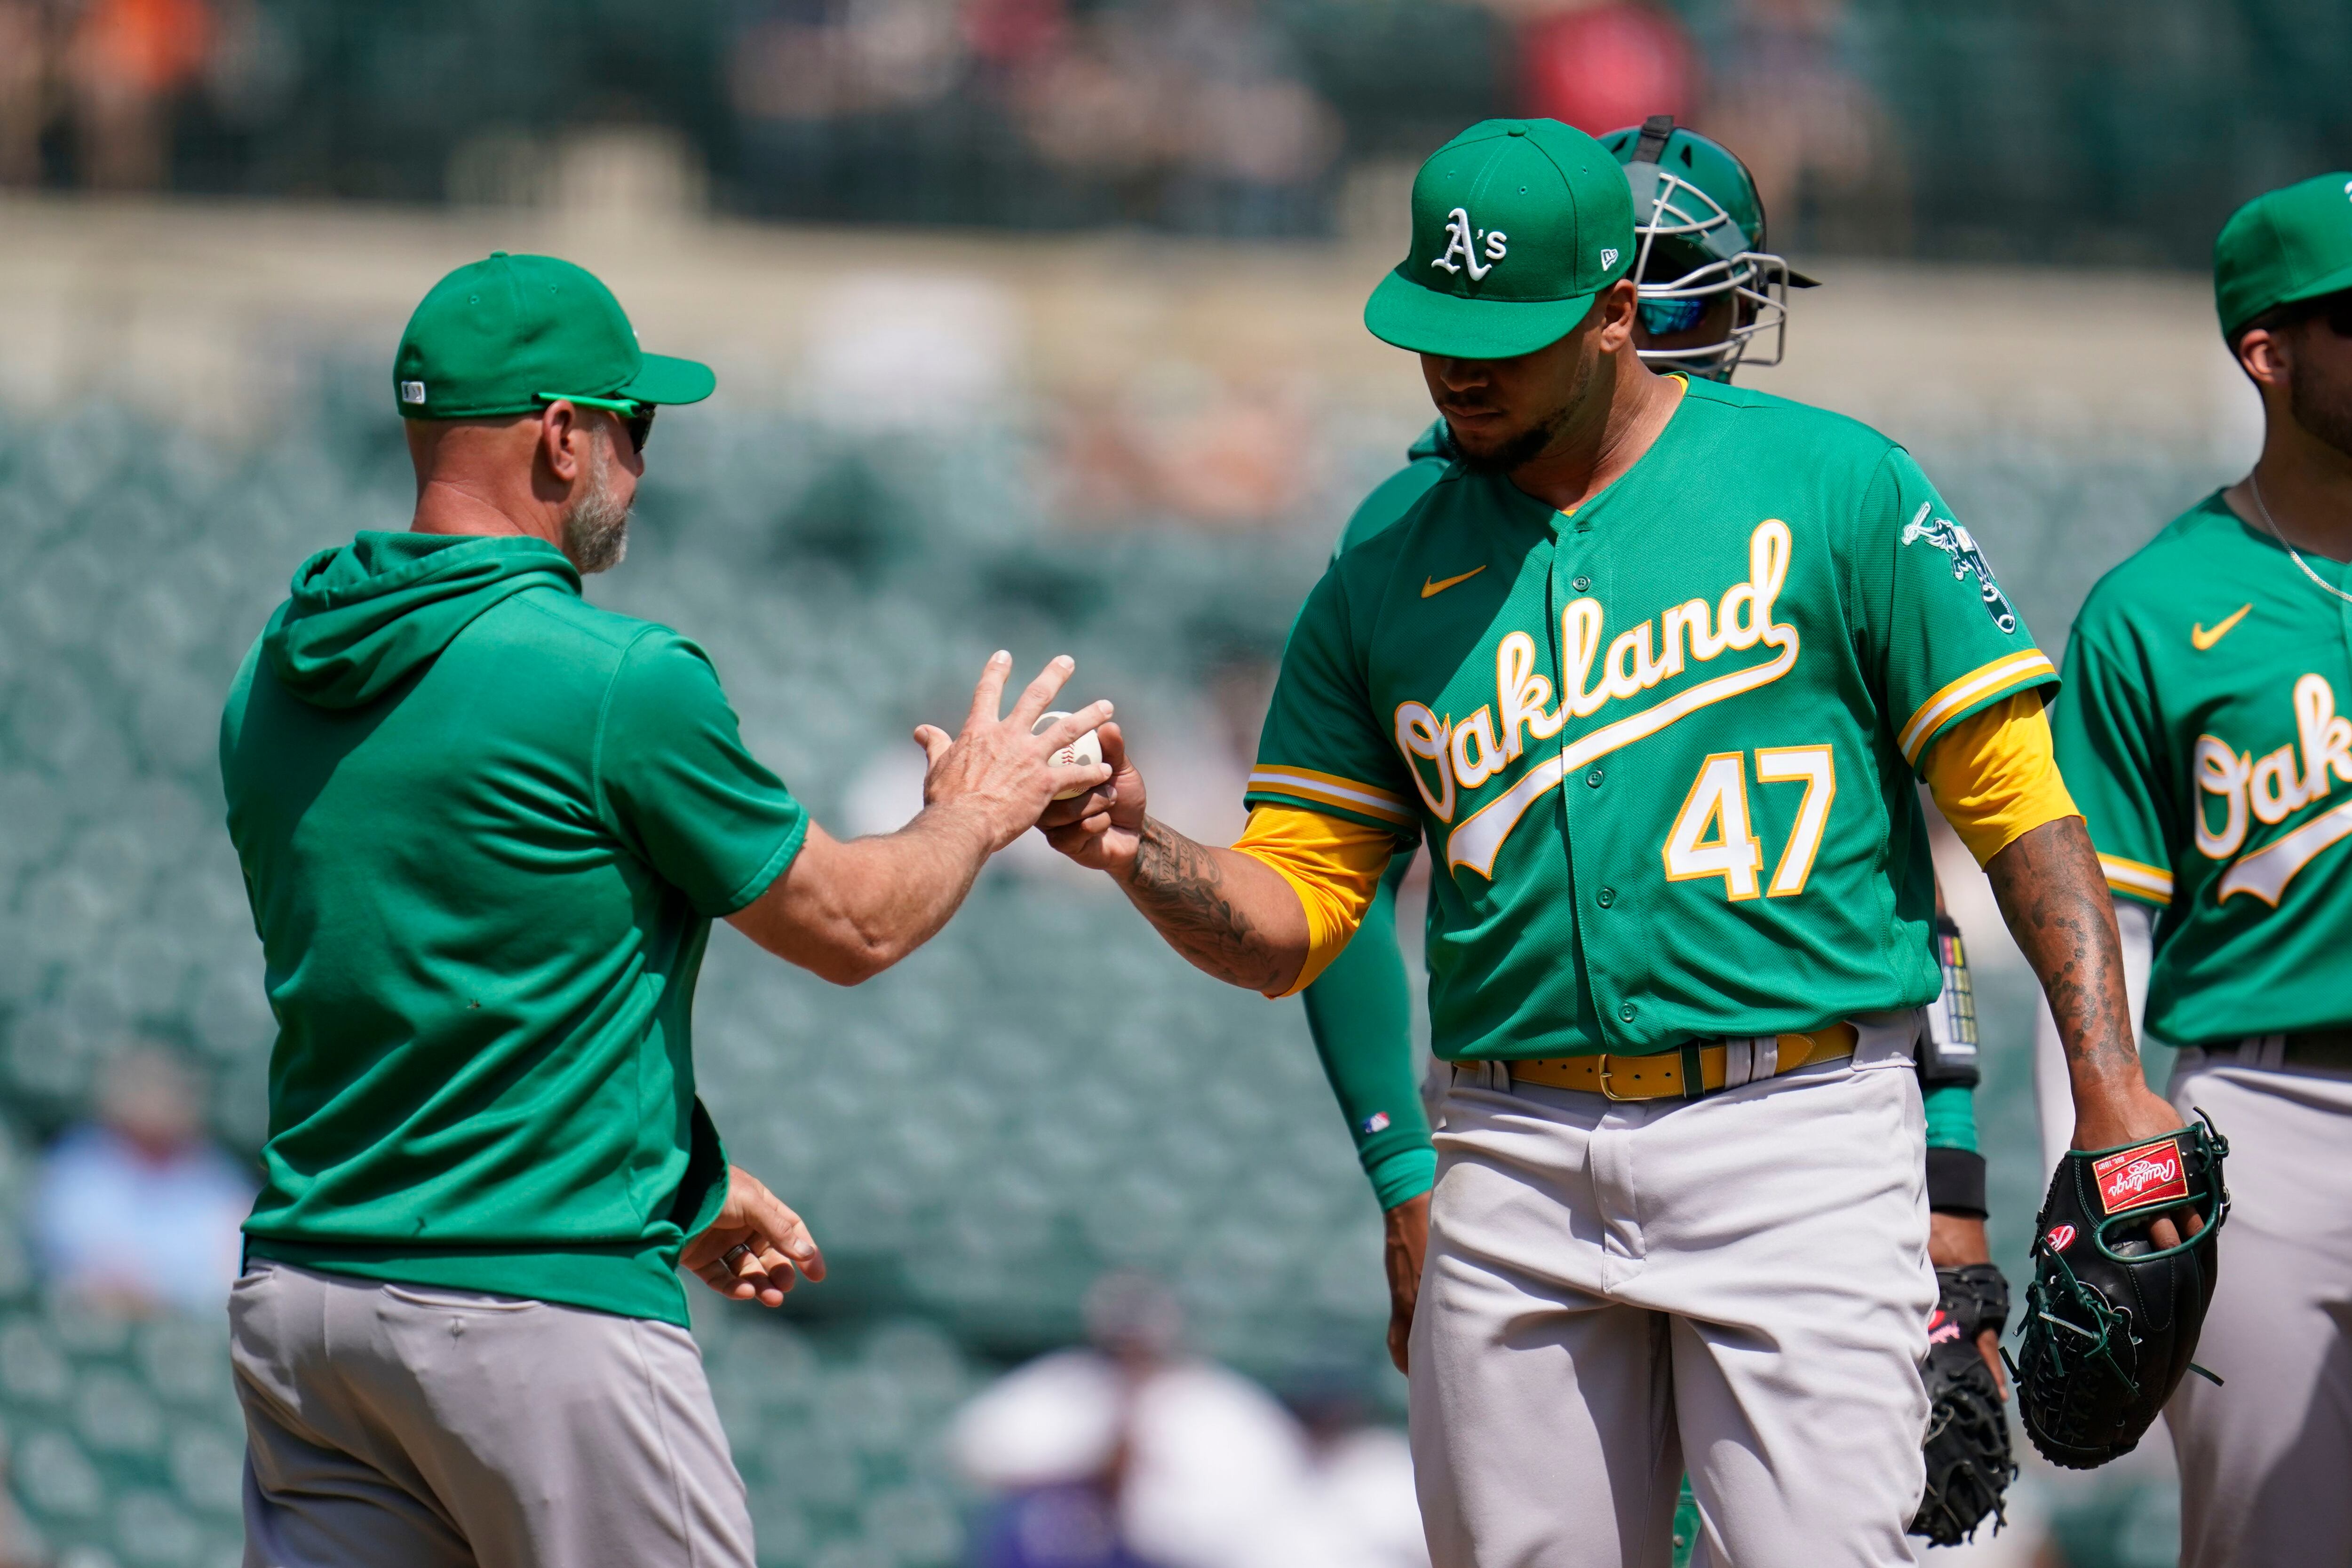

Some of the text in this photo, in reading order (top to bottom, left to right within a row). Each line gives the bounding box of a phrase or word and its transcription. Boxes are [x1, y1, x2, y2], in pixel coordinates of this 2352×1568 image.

[1431, 208, 1507, 281] A's
[1395, 519, 1799, 823] Oakland
[1662, 744, 1836, 902] 47
[2108, 1159, 2175, 1197] Rawlings
